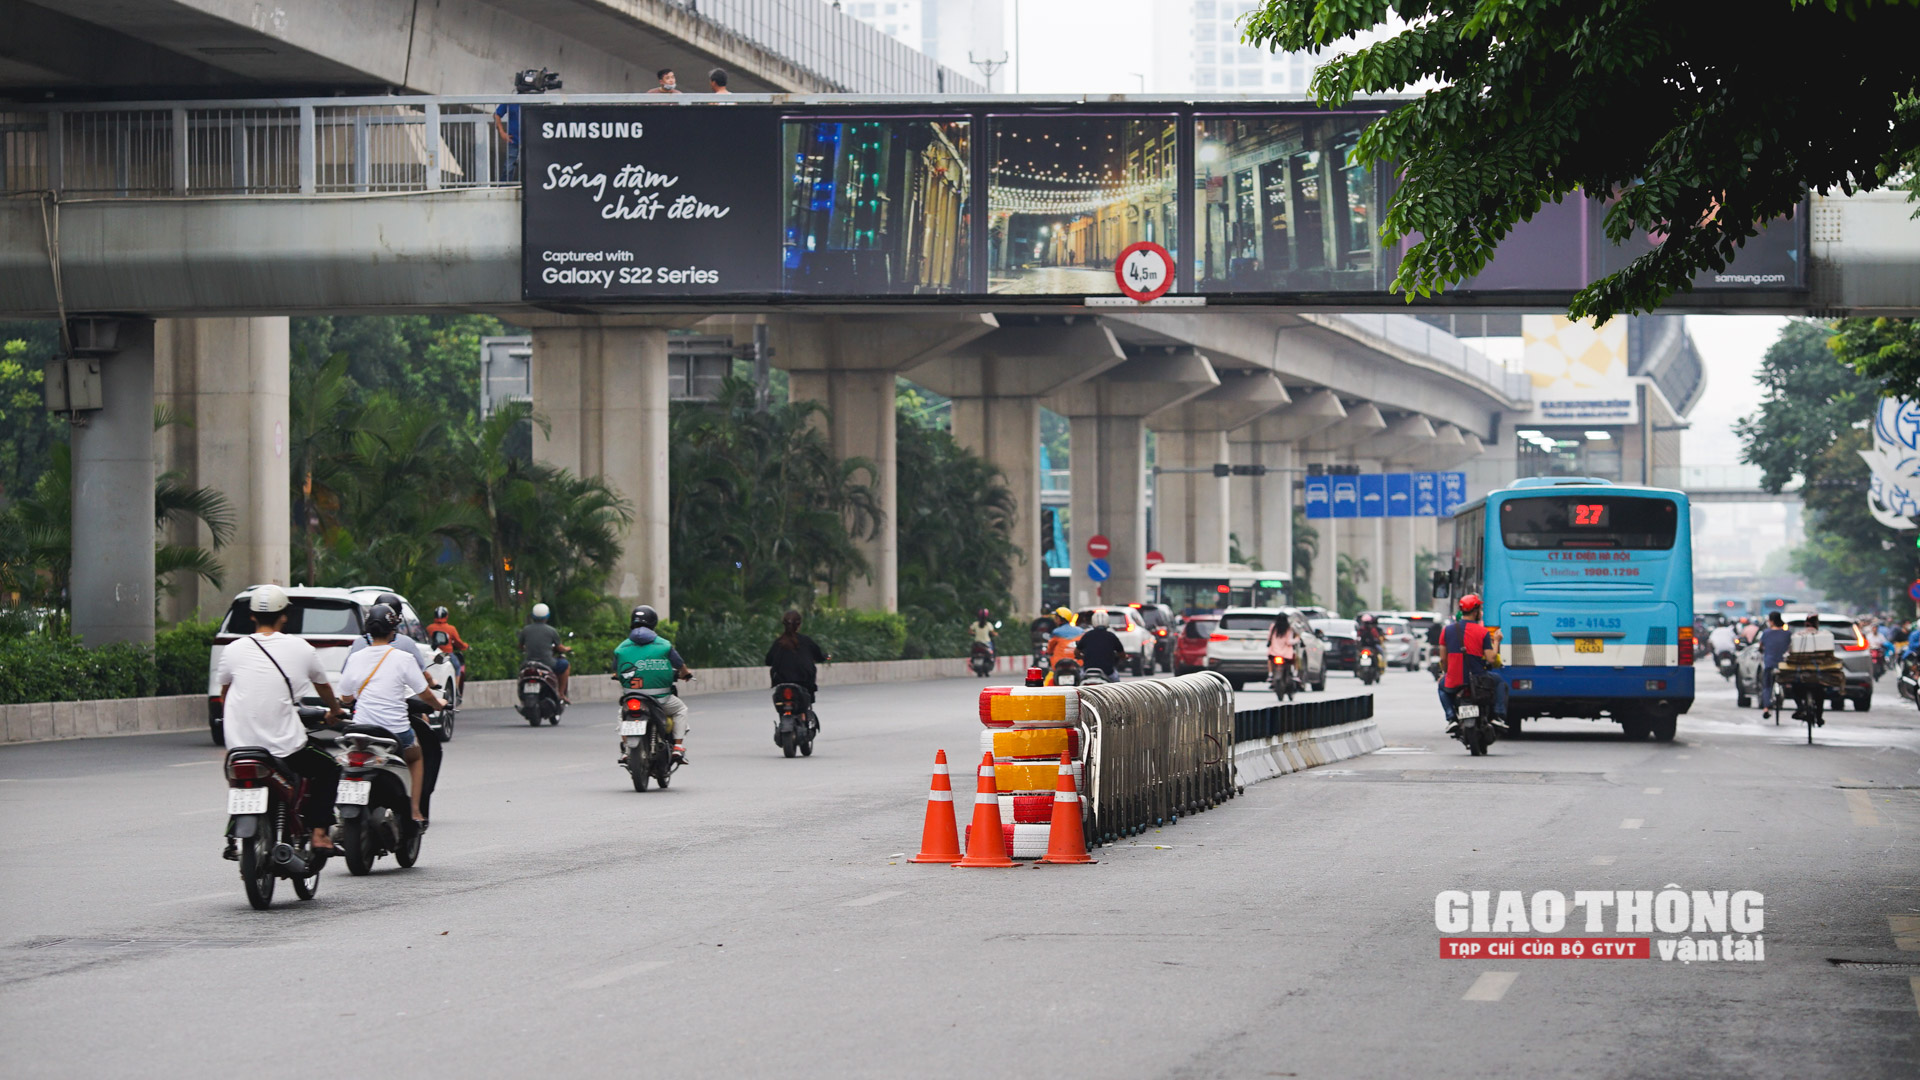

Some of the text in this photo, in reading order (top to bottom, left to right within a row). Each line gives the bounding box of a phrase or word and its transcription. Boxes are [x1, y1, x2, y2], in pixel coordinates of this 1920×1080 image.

[542, 122, 643, 139] SAMSUNG
[543, 162, 678, 202] Sống đậm
[601, 192, 730, 220] chất đêm
[542, 250, 634, 264] Captured with
[542, 266, 719, 288] Galaxy S22 Series
[1715, 273, 1785, 284] samsung.com
[1575, 504, 1603, 524] 27
[1556, 617, 1576, 628] 29B
[1586, 618, 1621, 629] 414.53
